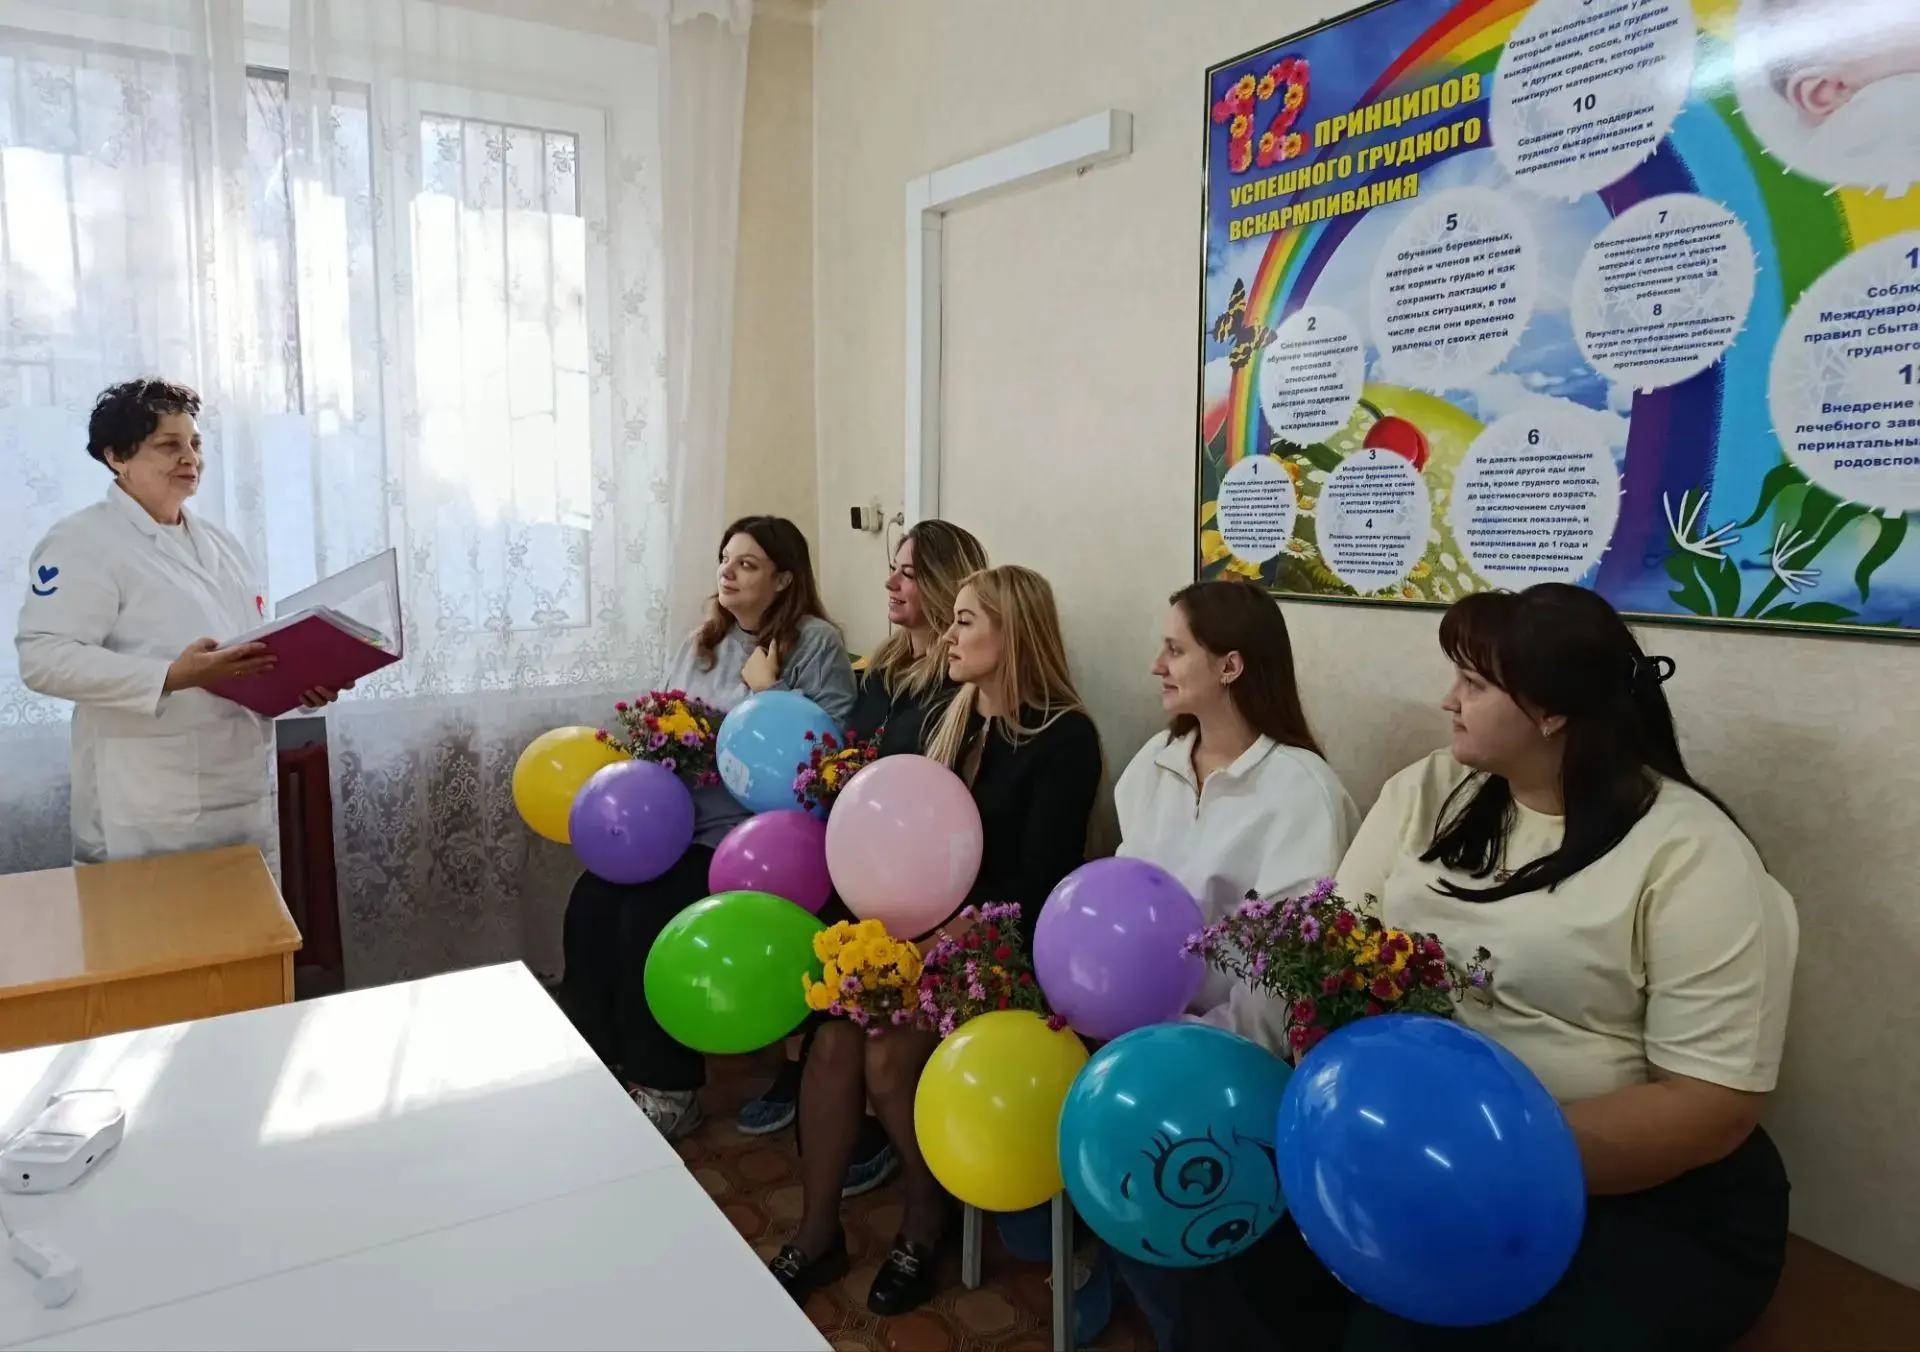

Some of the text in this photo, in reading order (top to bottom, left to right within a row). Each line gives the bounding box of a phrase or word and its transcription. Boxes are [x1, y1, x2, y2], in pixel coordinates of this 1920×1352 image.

[1508, 35, 1536, 49] Отказ
[1538, 31, 1548, 39] от
[1551, 4, 1628, 33] использования
[1513, 6, 1668, 62] которые находятся на грудном
[1503, 18, 1678, 79] выкармливании, сосок, пустышек
[1529, 70, 1562, 87] других
[1565, 57, 1607, 74] средств,
[1610, 41, 1654, 60] которые
[1511, 84, 1562, 104] имитируют
[1565, 63, 1634, 88] материнскую
[1212, 55, 1310, 174] 12
[1314, 72, 1481, 148] ПРИНЦИПОВ
[1573, 94, 1596, 113] 10
[1517, 105, 1654, 146] Создание групп поддержки
[1517, 120, 1652, 161] грудного выкармливания и
[1230, 117, 1481, 208] УСПЕШНОГО ГРУДНОГО
[1514, 155, 1576, 175] направление
[1588, 147, 1608, 157] ним
[1611, 135, 1655, 151] матерей
[1229, 173, 1419, 242] ВСКАРМЛИВАНИЯ
[1446, 214, 1457, 230] 5
[1397, 232, 1512, 260] Обучение беременных,
[1386, 265, 1424, 277] матерей
[1435, 256, 1470, 268] членов
[1487, 247, 1520, 259] семей
[1389, 264, 1515, 292] как кормить грудью и как
[1396, 293, 1445, 306] сохранить
[1447, 283, 1497, 297] лактацию
[1386, 310, 1429, 322] сложных
[1432, 302, 1485, 315] ситуациях,
[1497, 296, 1516, 305] том
[1819, 303, 1920, 322] Междунаро
[1387, 327, 1414, 336] числе
[1417, 323, 1440, 332] если
[1464, 313, 1514, 327] временно
[1804, 322, 1918, 344] правил сбыта
[1391, 340, 1432, 353] удалены
[1447, 334, 1476, 344] своих
[1478, 329, 1508, 341] детей
[1847, 341, 1920, 358] грудного
[1821, 399, 1914, 413] Внедрение
[1795, 420, 1880, 433] лечебного
[1369, 450, 1376, 460] 3
[1252, 464, 1257, 475] 1
[1366, 519, 1372, 528] 4
